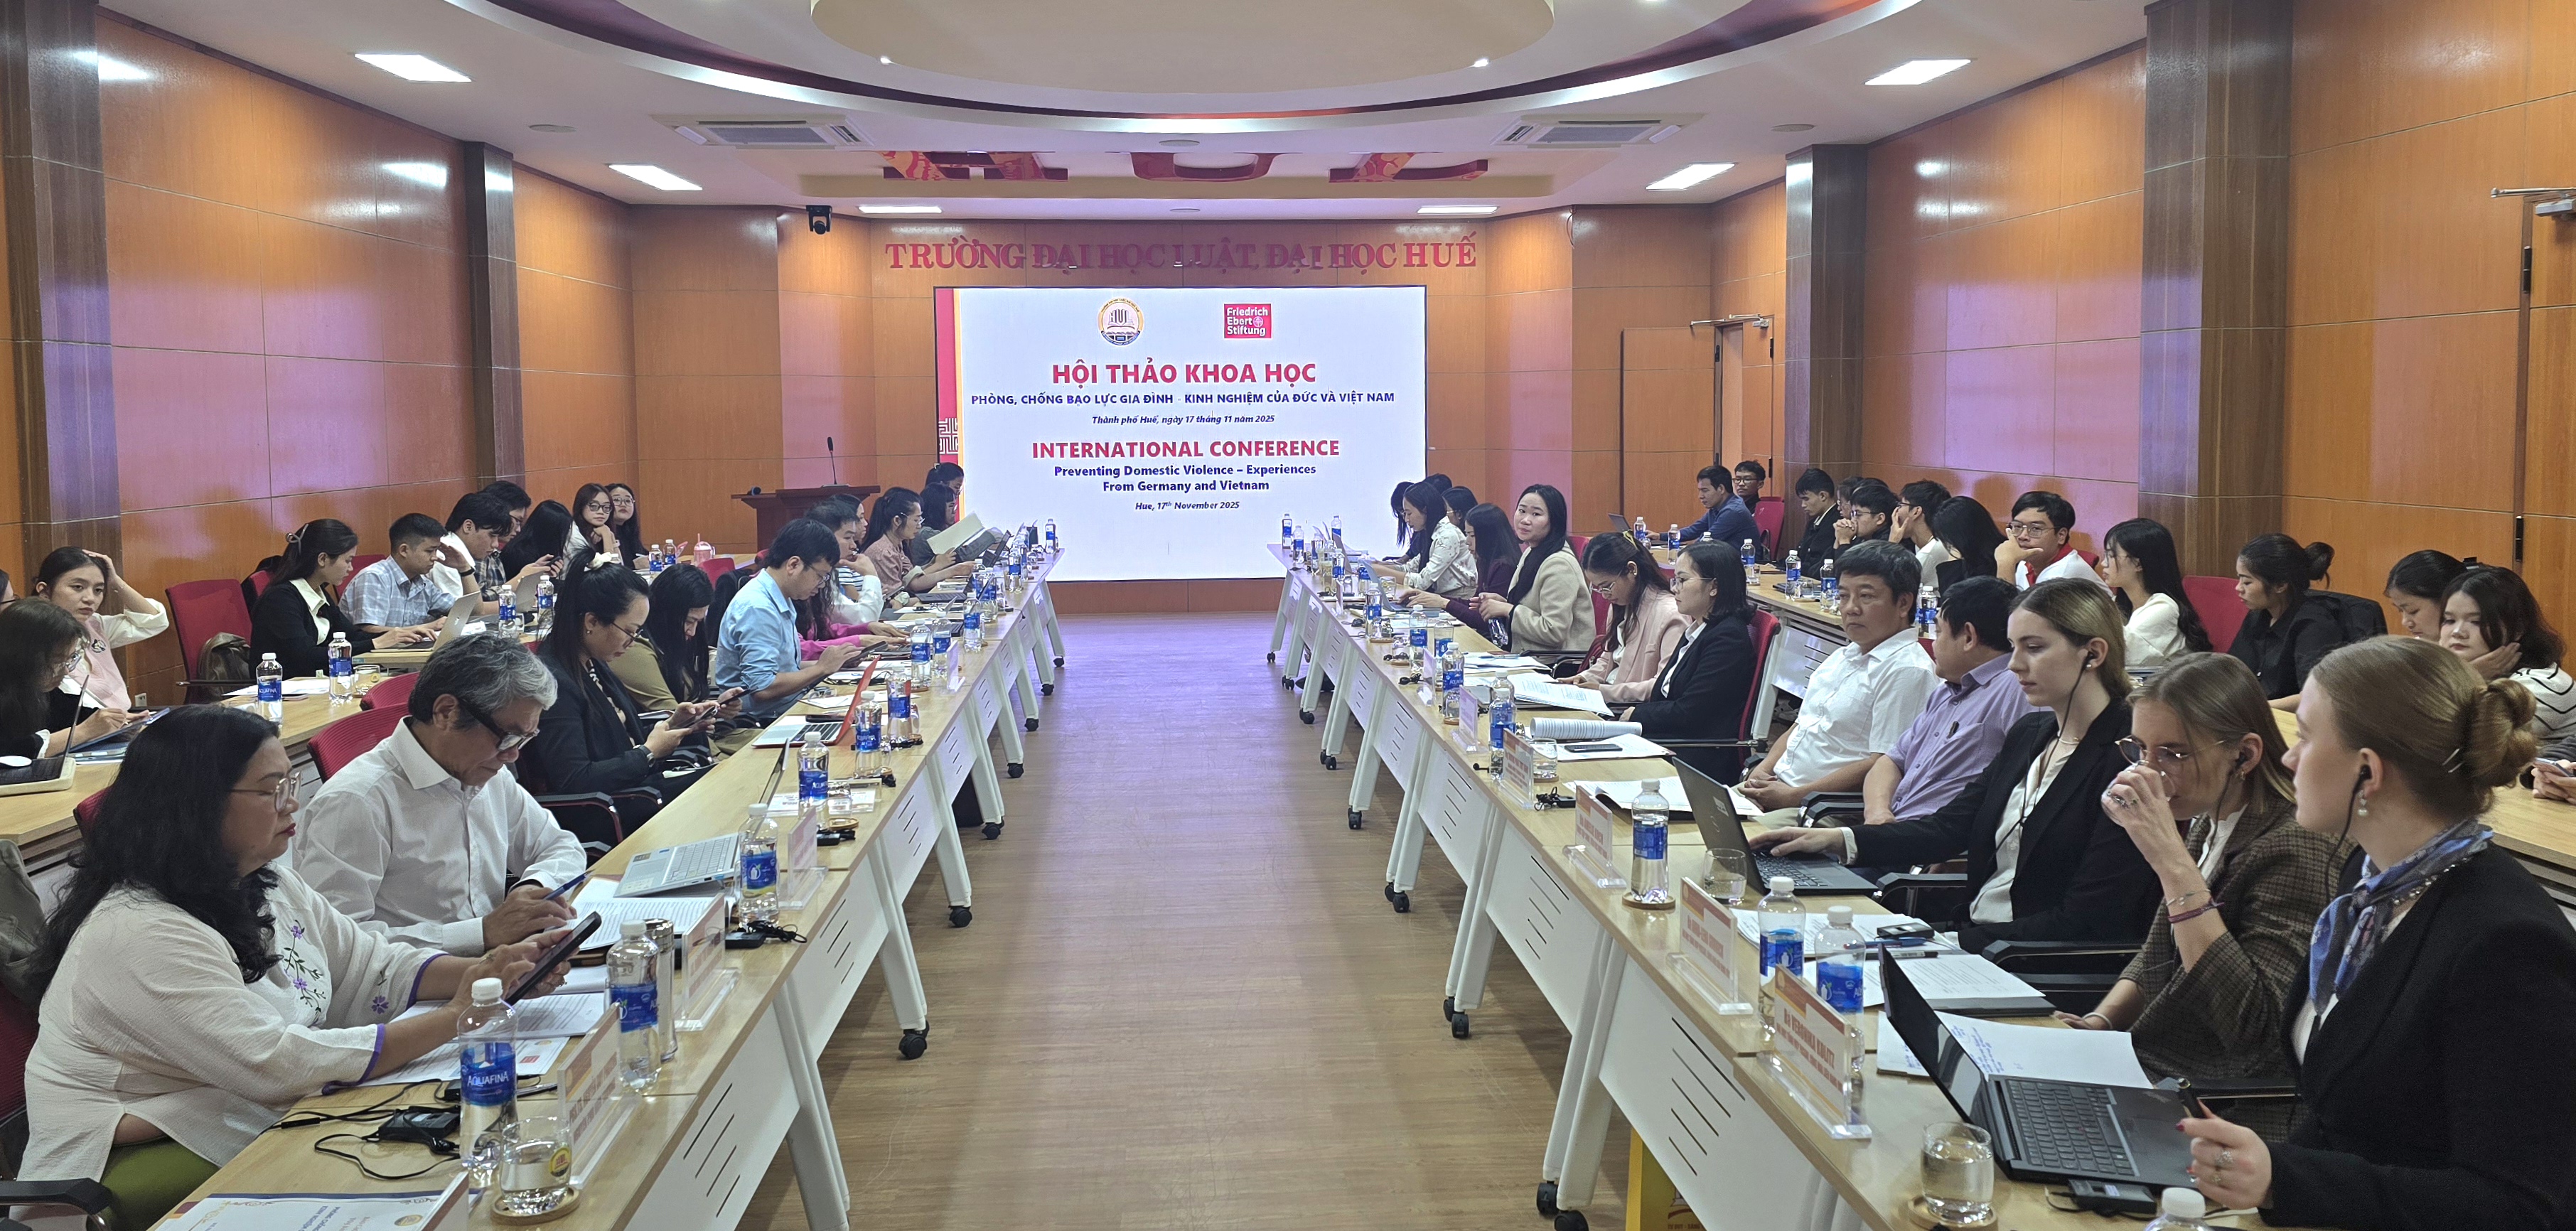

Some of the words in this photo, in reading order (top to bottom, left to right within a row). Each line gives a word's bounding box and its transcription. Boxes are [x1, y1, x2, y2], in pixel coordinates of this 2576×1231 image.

[885, 235, 1026, 269] TRƯỜNG
[1031, 243, 1095, 274] ĐẠI
[1097, 243, 1166, 274] HỌC
[1265, 242, 1323, 274] ĐẠI
[1329, 242, 1397, 274] HỌC
[1402, 230, 1477, 268] HUẾ
[1227, 307, 1268, 316] Friedrich
[1227, 316, 1252, 325] Ebert
[1227, 326, 1266, 336] Stiftung
[1053, 358, 1097, 389] HỘI
[1105, 357, 1177, 384] THẢO
[1185, 364, 1257, 382] KHOA
[1265, 363, 1316, 387] HỌC
[971, 392, 1017, 405] PHÒNG,
[1021, 392, 1063, 404] CHỐNG
[1067, 395, 1090, 407] BẠO
[1095, 394, 1117, 407] LỰC
[1120, 394, 1140, 404] GIA
[1143, 392, 1173, 404] ĐÌNH
[1185, 394, 1213, 403] KINH
[1217, 392, 1263, 406] NGHIỆM
[1267, 390, 1289, 403] CỦA
[1292, 390, 1317, 402] ĐỨC
[1321, 391, 1336, 402] VÀ
[1339, 390, 1363, 404] VIỆT
[1367, 392, 1395, 402] NAM
[1121, 415, 1138, 425] phố
[1140, 414, 1159, 424] Huế,
[1161, 415, 1184, 425] ngày
[1196, 414, 1222, 424] tháng
[1033, 441, 1203, 458] INTERNATIONAL
[1210, 440, 1339, 456] CONFERENCE
[1054, 466, 1120, 478] Preventing
[1124, 465, 1180, 475] Domestic
[1184, 464, 1233, 475] Violence
[1246, 464, 1316, 477] Experiences
[1103, 482, 1134, 491] From
[1137, 481, 1191, 493] Germany
[1194, 480, 1216, 490] and
[1220, 480, 1270, 490] Vietnam
[1135, 502, 1155, 511] Hue,
[467, 1071, 509, 1087] AQUAFINA
